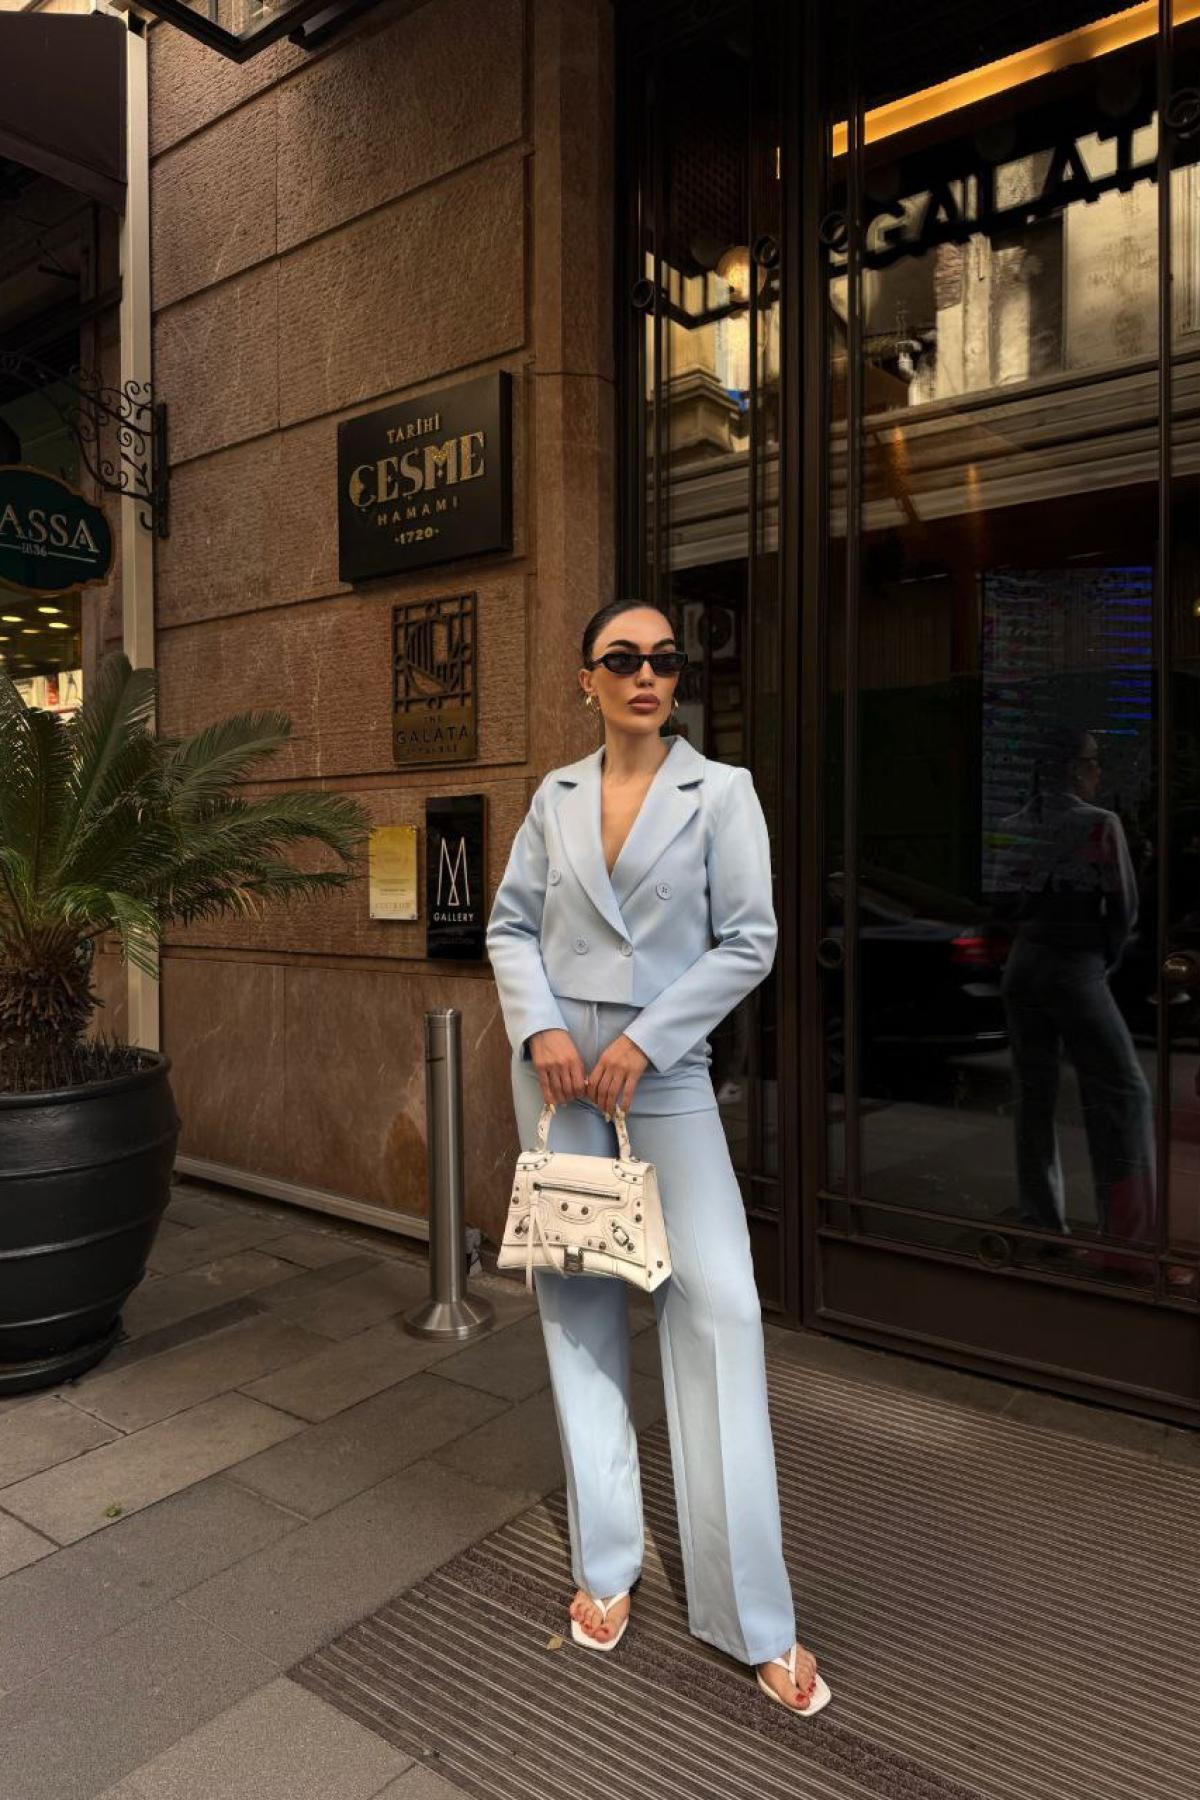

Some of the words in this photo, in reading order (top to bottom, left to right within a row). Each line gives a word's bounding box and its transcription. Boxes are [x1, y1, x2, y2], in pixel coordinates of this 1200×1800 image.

[377, 496, 458, 526] HAMAMI
[396, 724, 469, 745] GALATA
[433, 911, 475, 922] GALLERY
